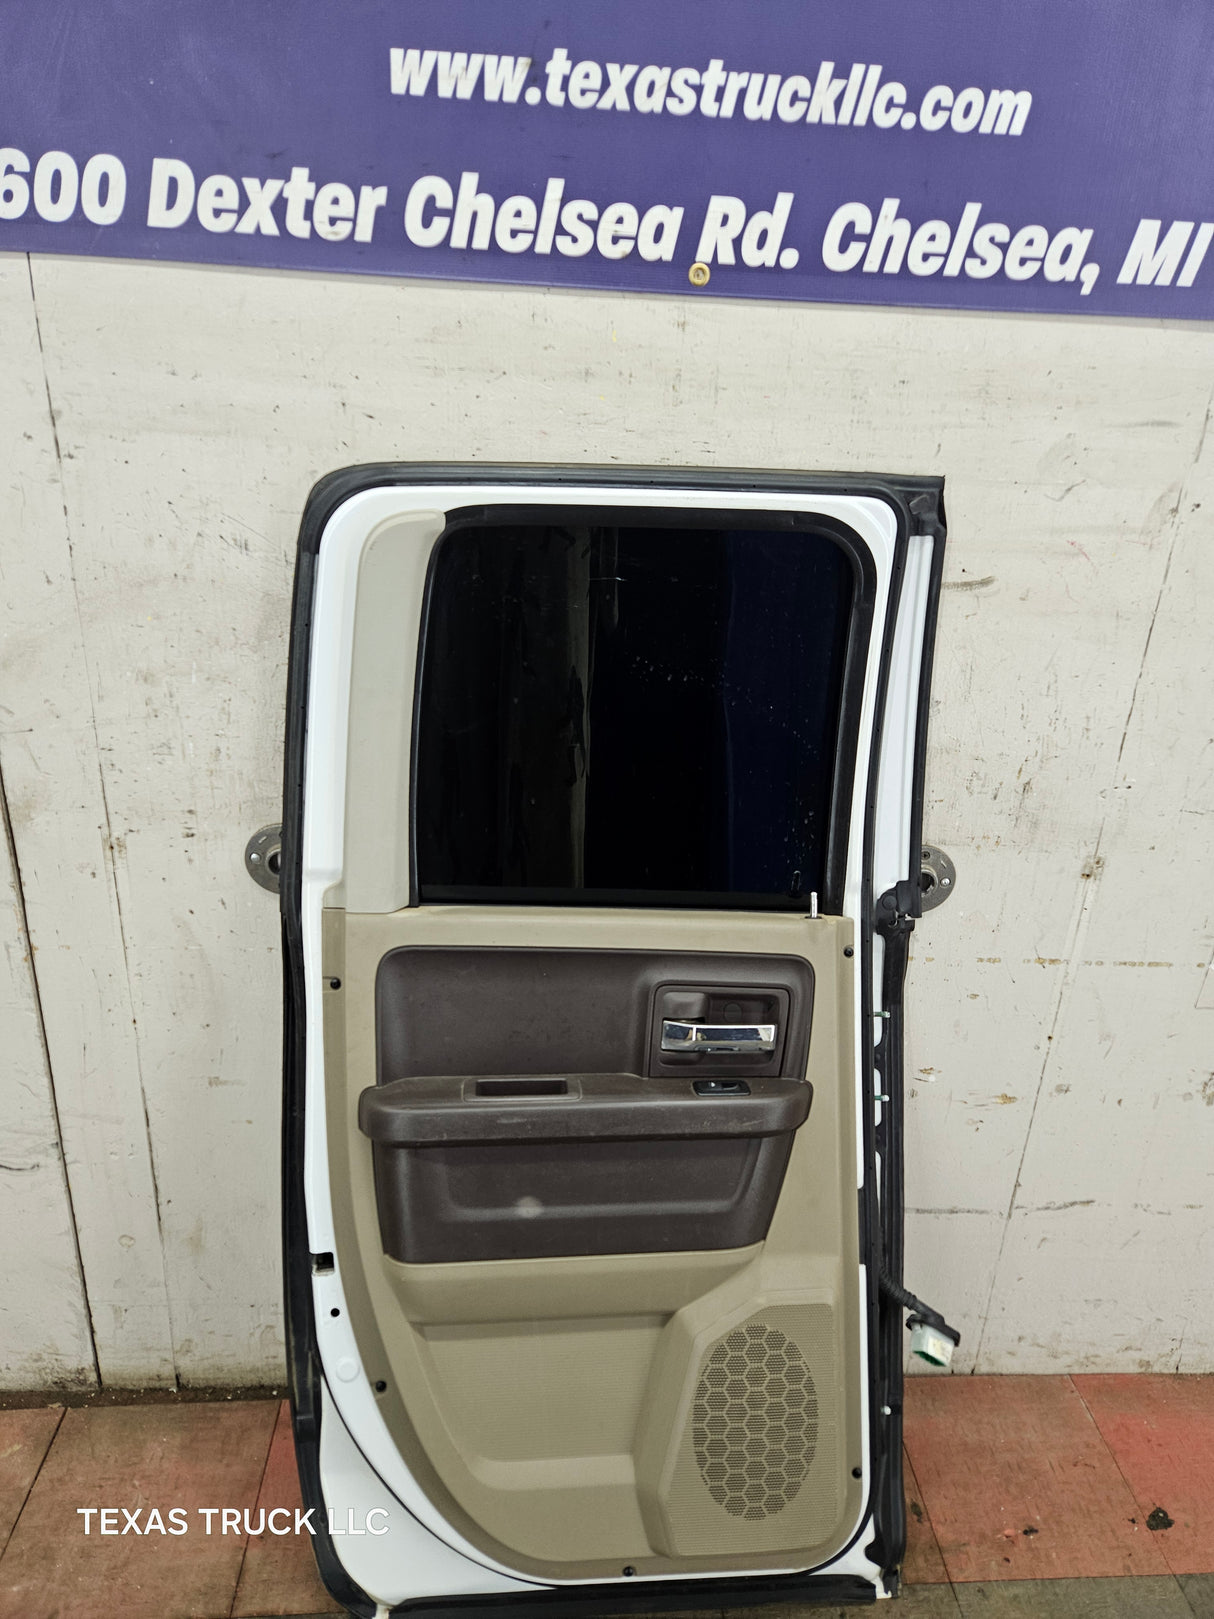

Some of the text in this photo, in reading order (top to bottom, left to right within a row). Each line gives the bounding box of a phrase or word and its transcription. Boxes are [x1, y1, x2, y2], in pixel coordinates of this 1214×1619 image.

[389, 47, 1033, 136] www.texastruckllc.com
[147, 157, 388, 243] Dexter
[404, 171, 685, 262] Chelsea
[695, 191, 800, 269] Rd.
[822, 197, 1100, 296] Chelsea,
[1116, 218, 1214, 288] MI
